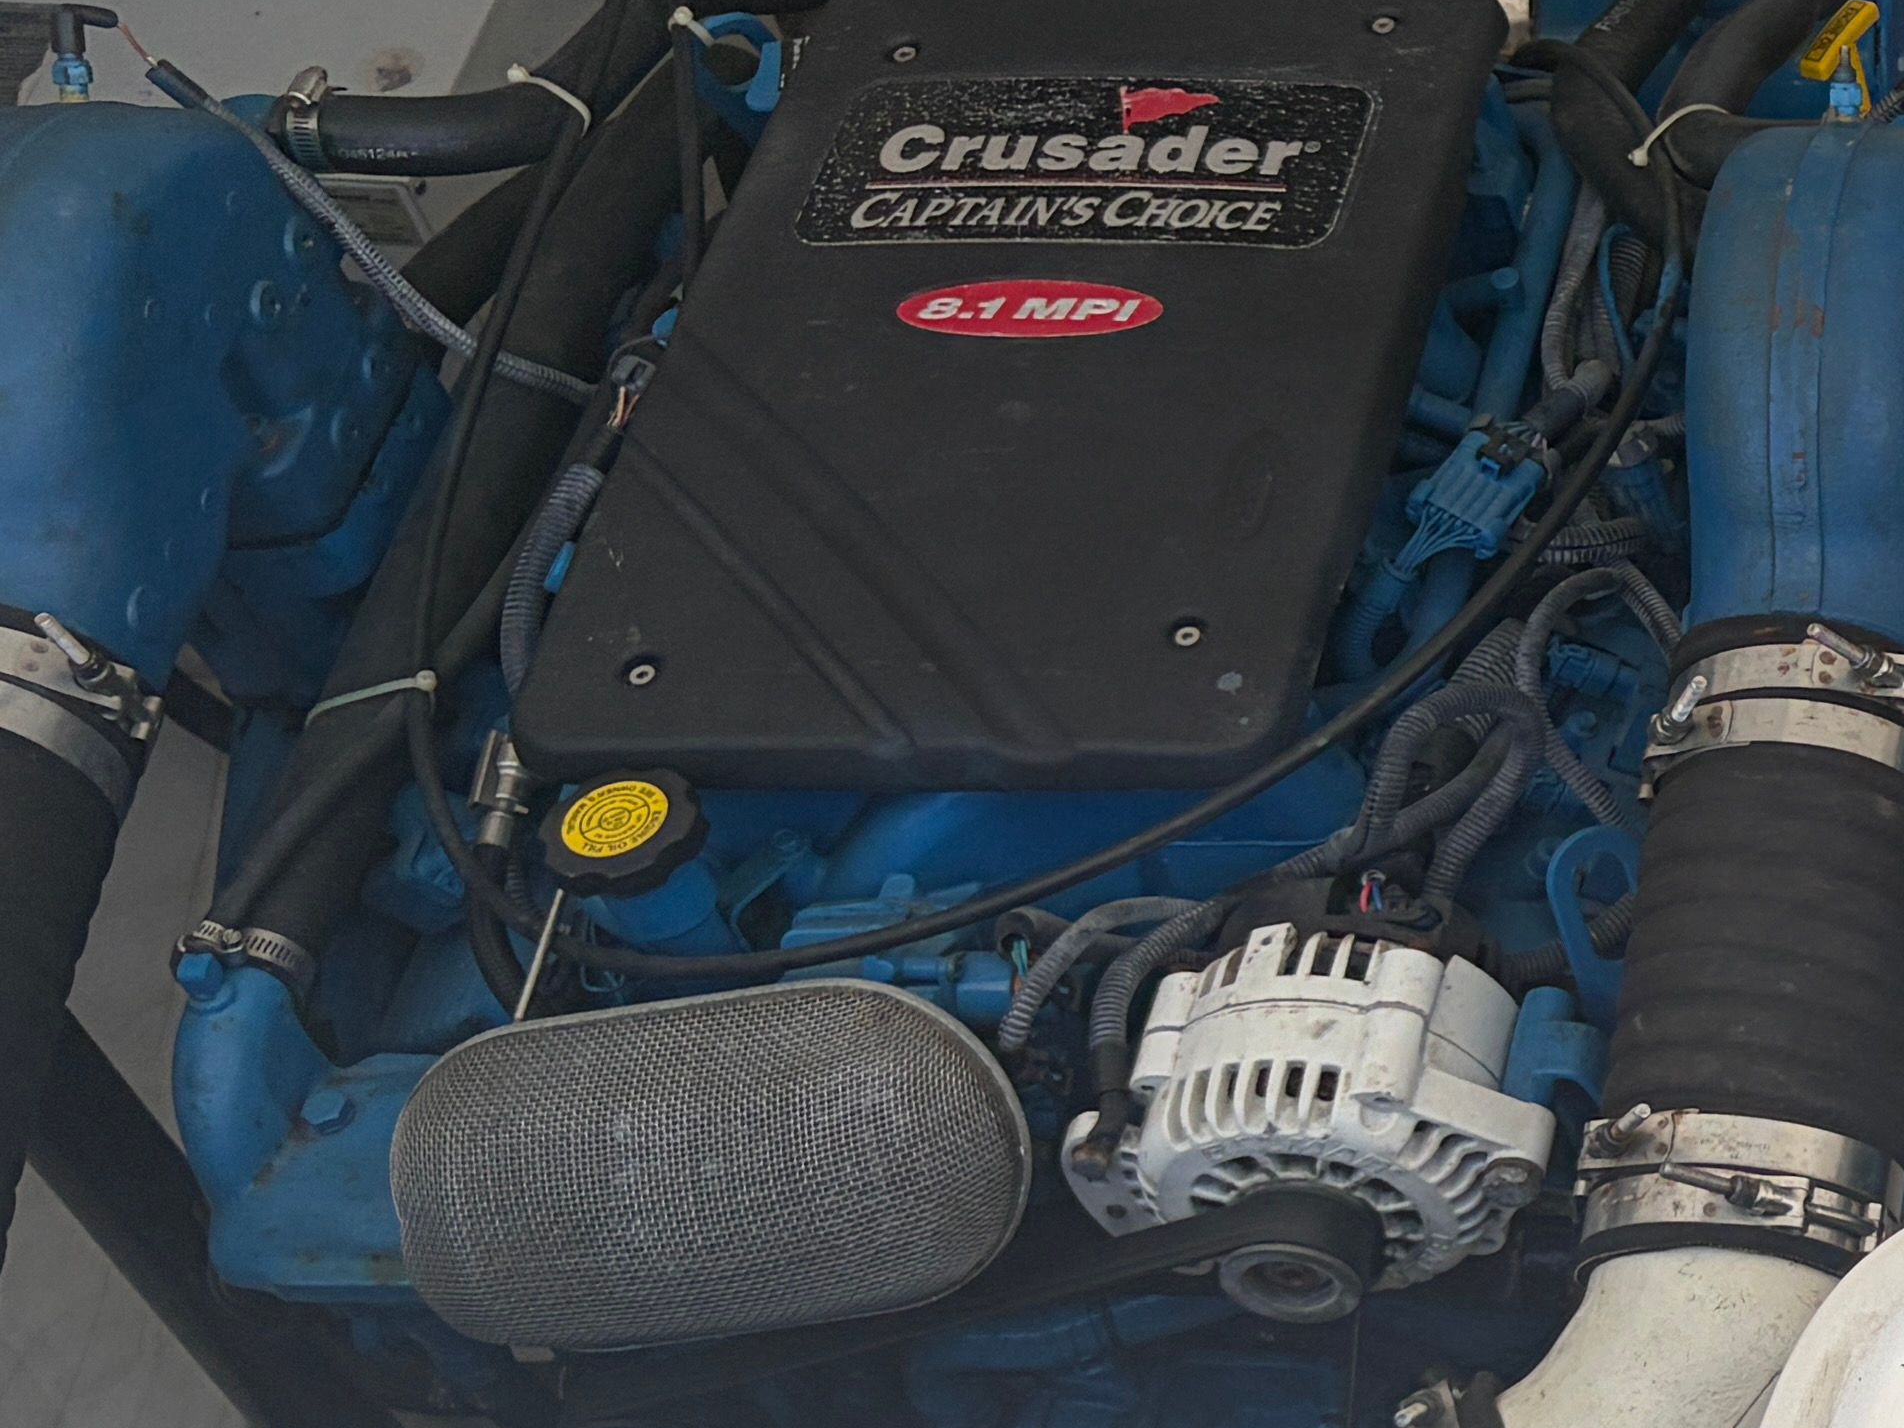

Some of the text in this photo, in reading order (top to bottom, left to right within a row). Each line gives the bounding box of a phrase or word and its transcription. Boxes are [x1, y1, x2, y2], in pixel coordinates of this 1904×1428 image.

[879, 124, 1304, 176] Crusader
[850, 190, 1281, 232] CAPTAIN'S CHOICE
[917, 297, 1141, 322] 8.1 MPI
